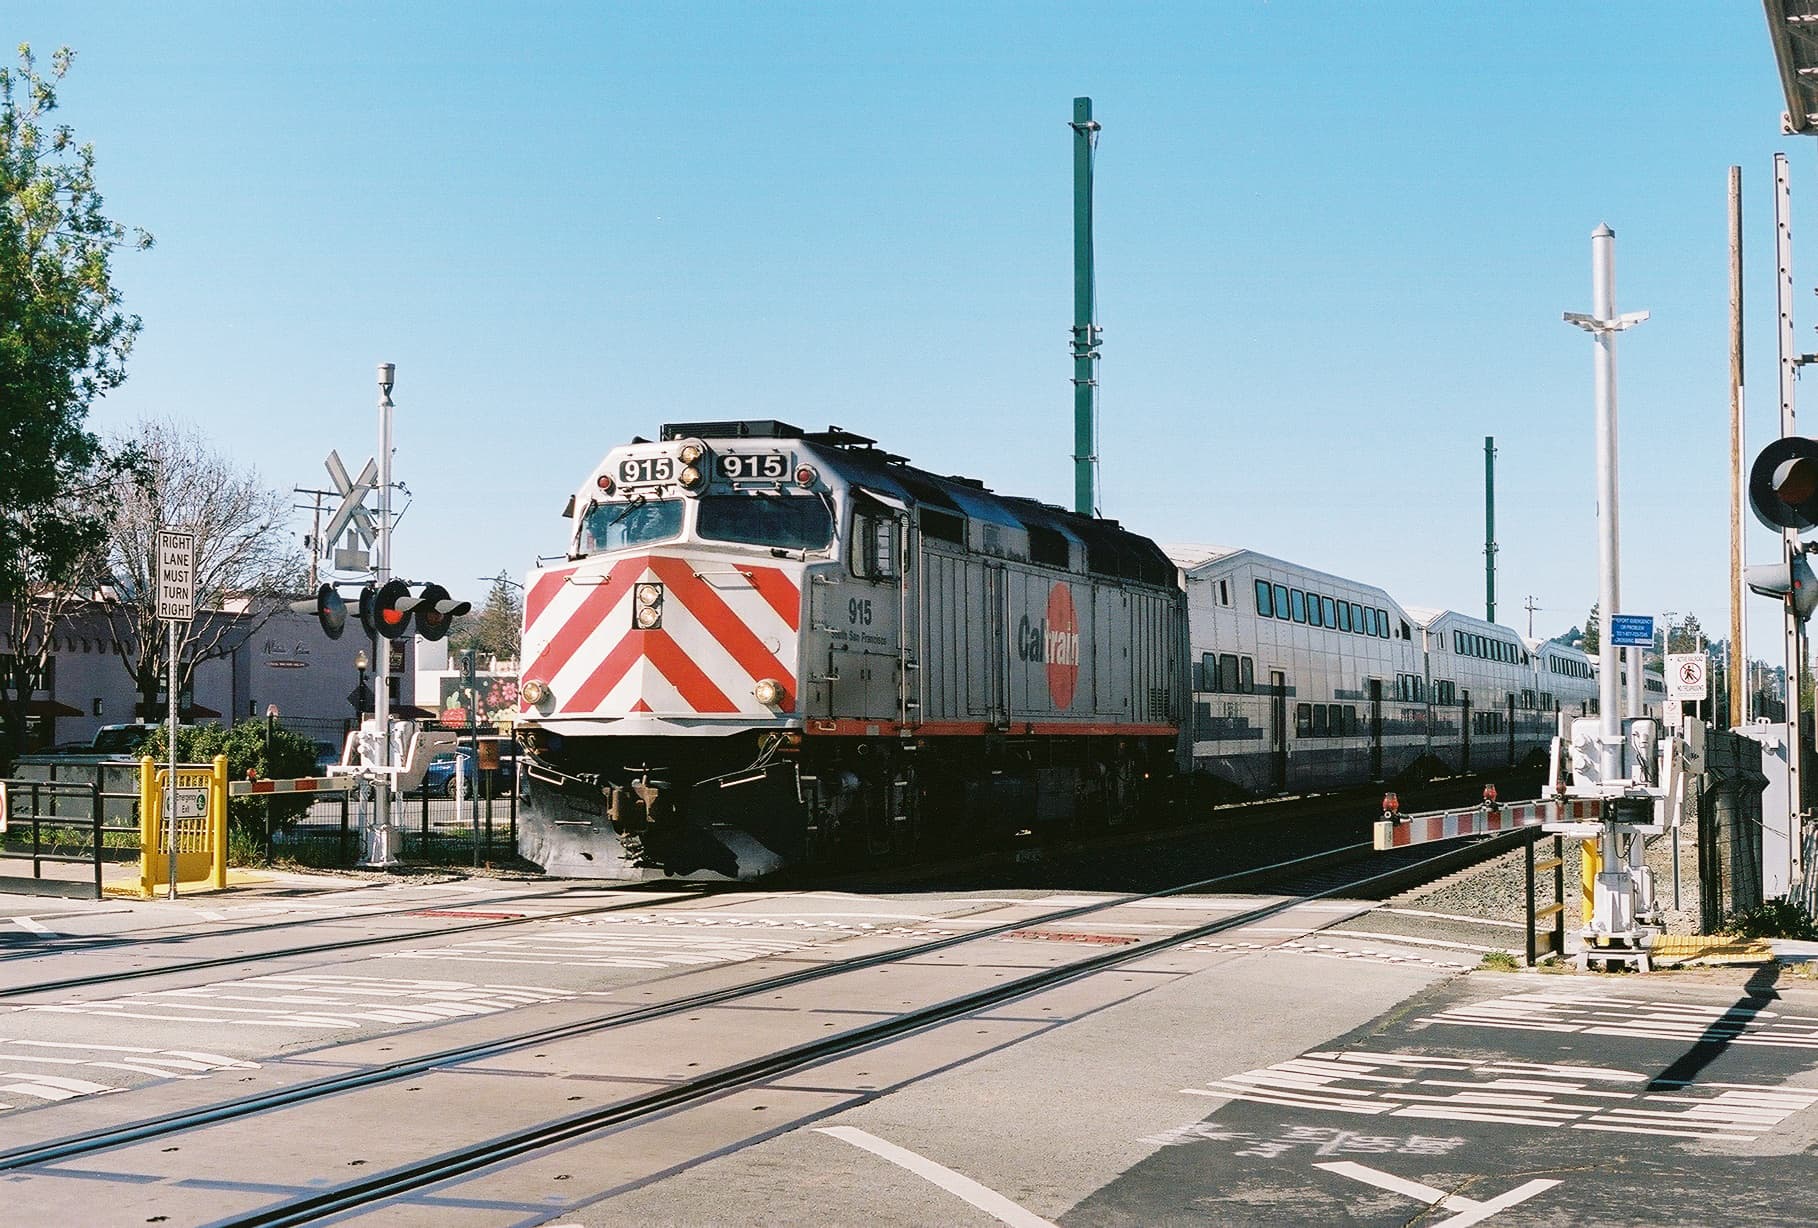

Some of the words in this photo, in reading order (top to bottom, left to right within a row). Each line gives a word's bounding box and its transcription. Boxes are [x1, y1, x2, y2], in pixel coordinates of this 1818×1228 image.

[625, 458, 670, 482] 915
[723, 456, 782, 478] 915
[162, 535, 191, 550] RIGHT
[164, 552, 190, 567] LANE
[163, 569, 189, 583] MUST
[163, 585, 189, 600] TURN
[161, 602, 191, 617] RIGHT
[848, 597, 872, 626] 915
[1018, 614, 1079, 666] Caltrain
[175, 793, 197, 803] Emergency
[182, 804, 190, 814] Exit
